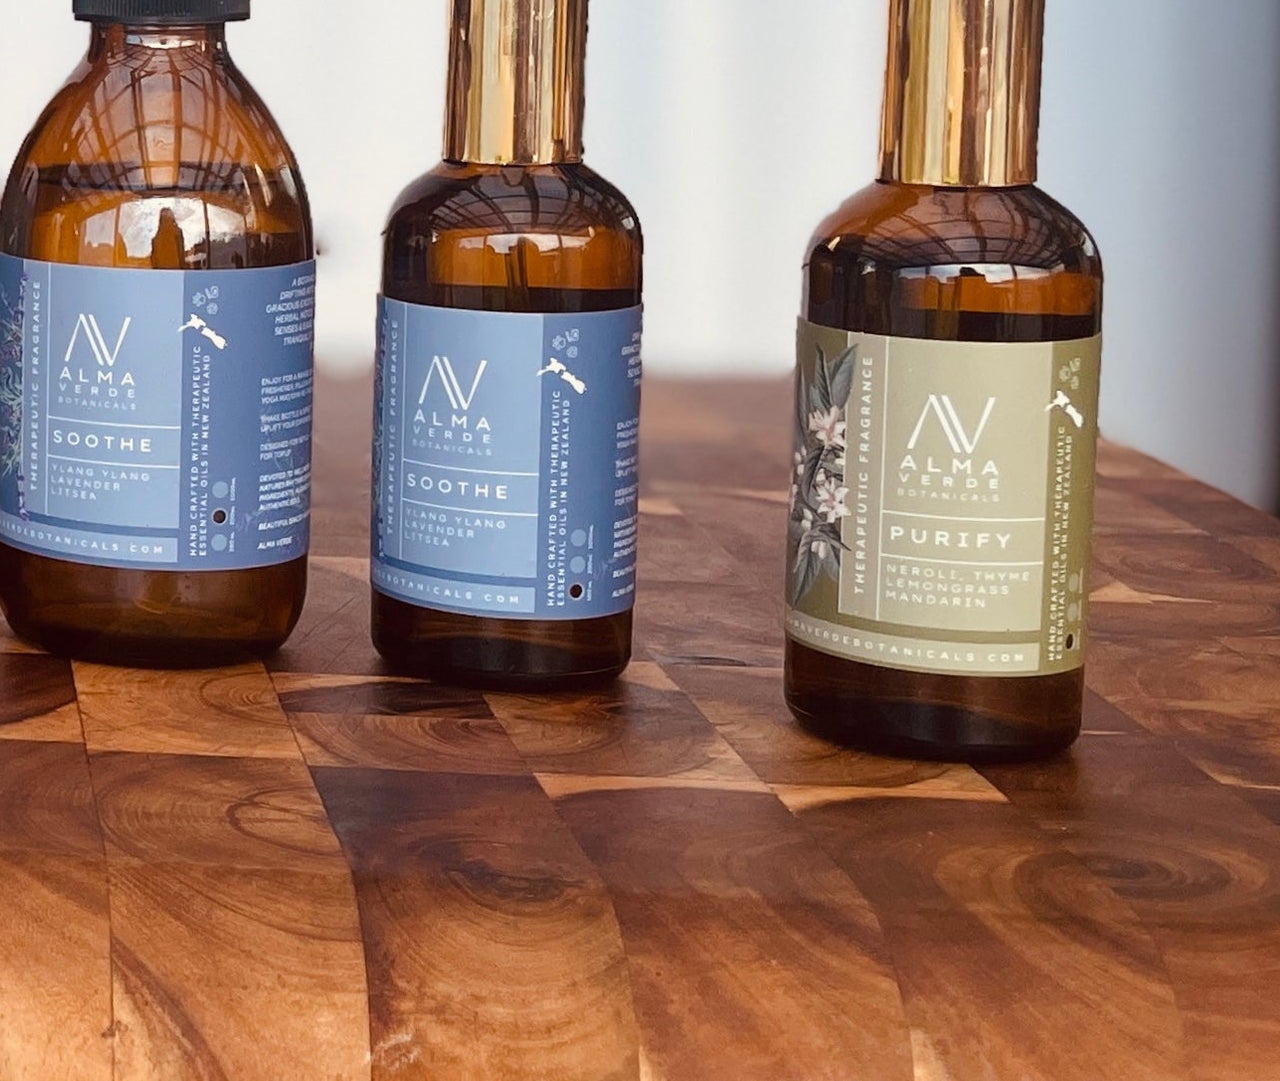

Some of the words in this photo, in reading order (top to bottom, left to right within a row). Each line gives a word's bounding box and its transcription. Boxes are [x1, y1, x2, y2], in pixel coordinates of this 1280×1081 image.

[32, 281, 41, 375] FRAGRANCE
[60, 366, 134, 386] ALMA
[390, 320, 398, 416] FRAGRANCE
[59, 382, 134, 398] VERDE
[192, 346, 200, 426] THERAPEUTIC
[201, 355, 210, 409] ZEALAND
[58, 396, 136, 410] BOTANICALS
[860, 356, 872, 462] FRAGRANCE
[201, 414, 209, 438] NEW
[414, 409, 490, 431] ALMA
[551, 391, 560, 474] THERAPEUTIC
[561, 400, 570, 455] ZEALAND
[30, 382, 39, 491] THERAPEUTIC
[54, 430, 151, 452] SOOTHE
[191, 433, 199, 460] WITH
[412, 438, 492, 456] BOTANICALS
[414, 424, 490, 444] VERDE
[52, 464, 94, 476] YLANG
[102, 469, 150, 482] YLANG
[200, 460, 208, 487] OILS
[560, 460, 568, 485] NEW
[900, 454, 998, 475] ALMA
[1054, 426, 1065, 517] THERAPEUTIC
[1063, 436, 1072, 496] ZEALAND
[50, 476, 120, 491] LAVENDER
[50, 488, 96, 500] LITSEA
[386, 426, 396, 536] THERAPEUTIC
[408, 474, 508, 499] SOOTHE
[900, 472, 998, 489] VERDE
[897, 488, 1000, 502] BOTANICALS
[199, 493, 208, 556] ESSENTIAL
[405, 518, 474, 538] LAVENDER
[406, 508, 446, 522] YLANG
[456, 516, 506, 529] YLANG
[559, 508, 567, 536] OILS
[1061, 502, 1069, 528] NEW
[190, 524, 198, 556] HAND
[404, 531, 449, 546] LITSEA
[548, 515, 557, 569] CRAFTED
[854, 472, 868, 594] THERAPEUTIC
[890, 526, 1010, 548] PURIFY
[1052, 523, 1060, 555] WITH
[557, 541, 566, 606] ESSENTIAL
[974, 572, 1030, 582] THYME
[1059, 553, 1067, 583] OILS
[547, 574, 556, 606] HAND
[886, 578, 1010, 596] LEMONGRASS
[886, 590, 986, 608] MANDARIN
[1050, 561, 1059, 620] CRAFTED
[1056, 591, 1065, 659] ESSENTIAL
[1048, 626, 1057, 661] HAND
